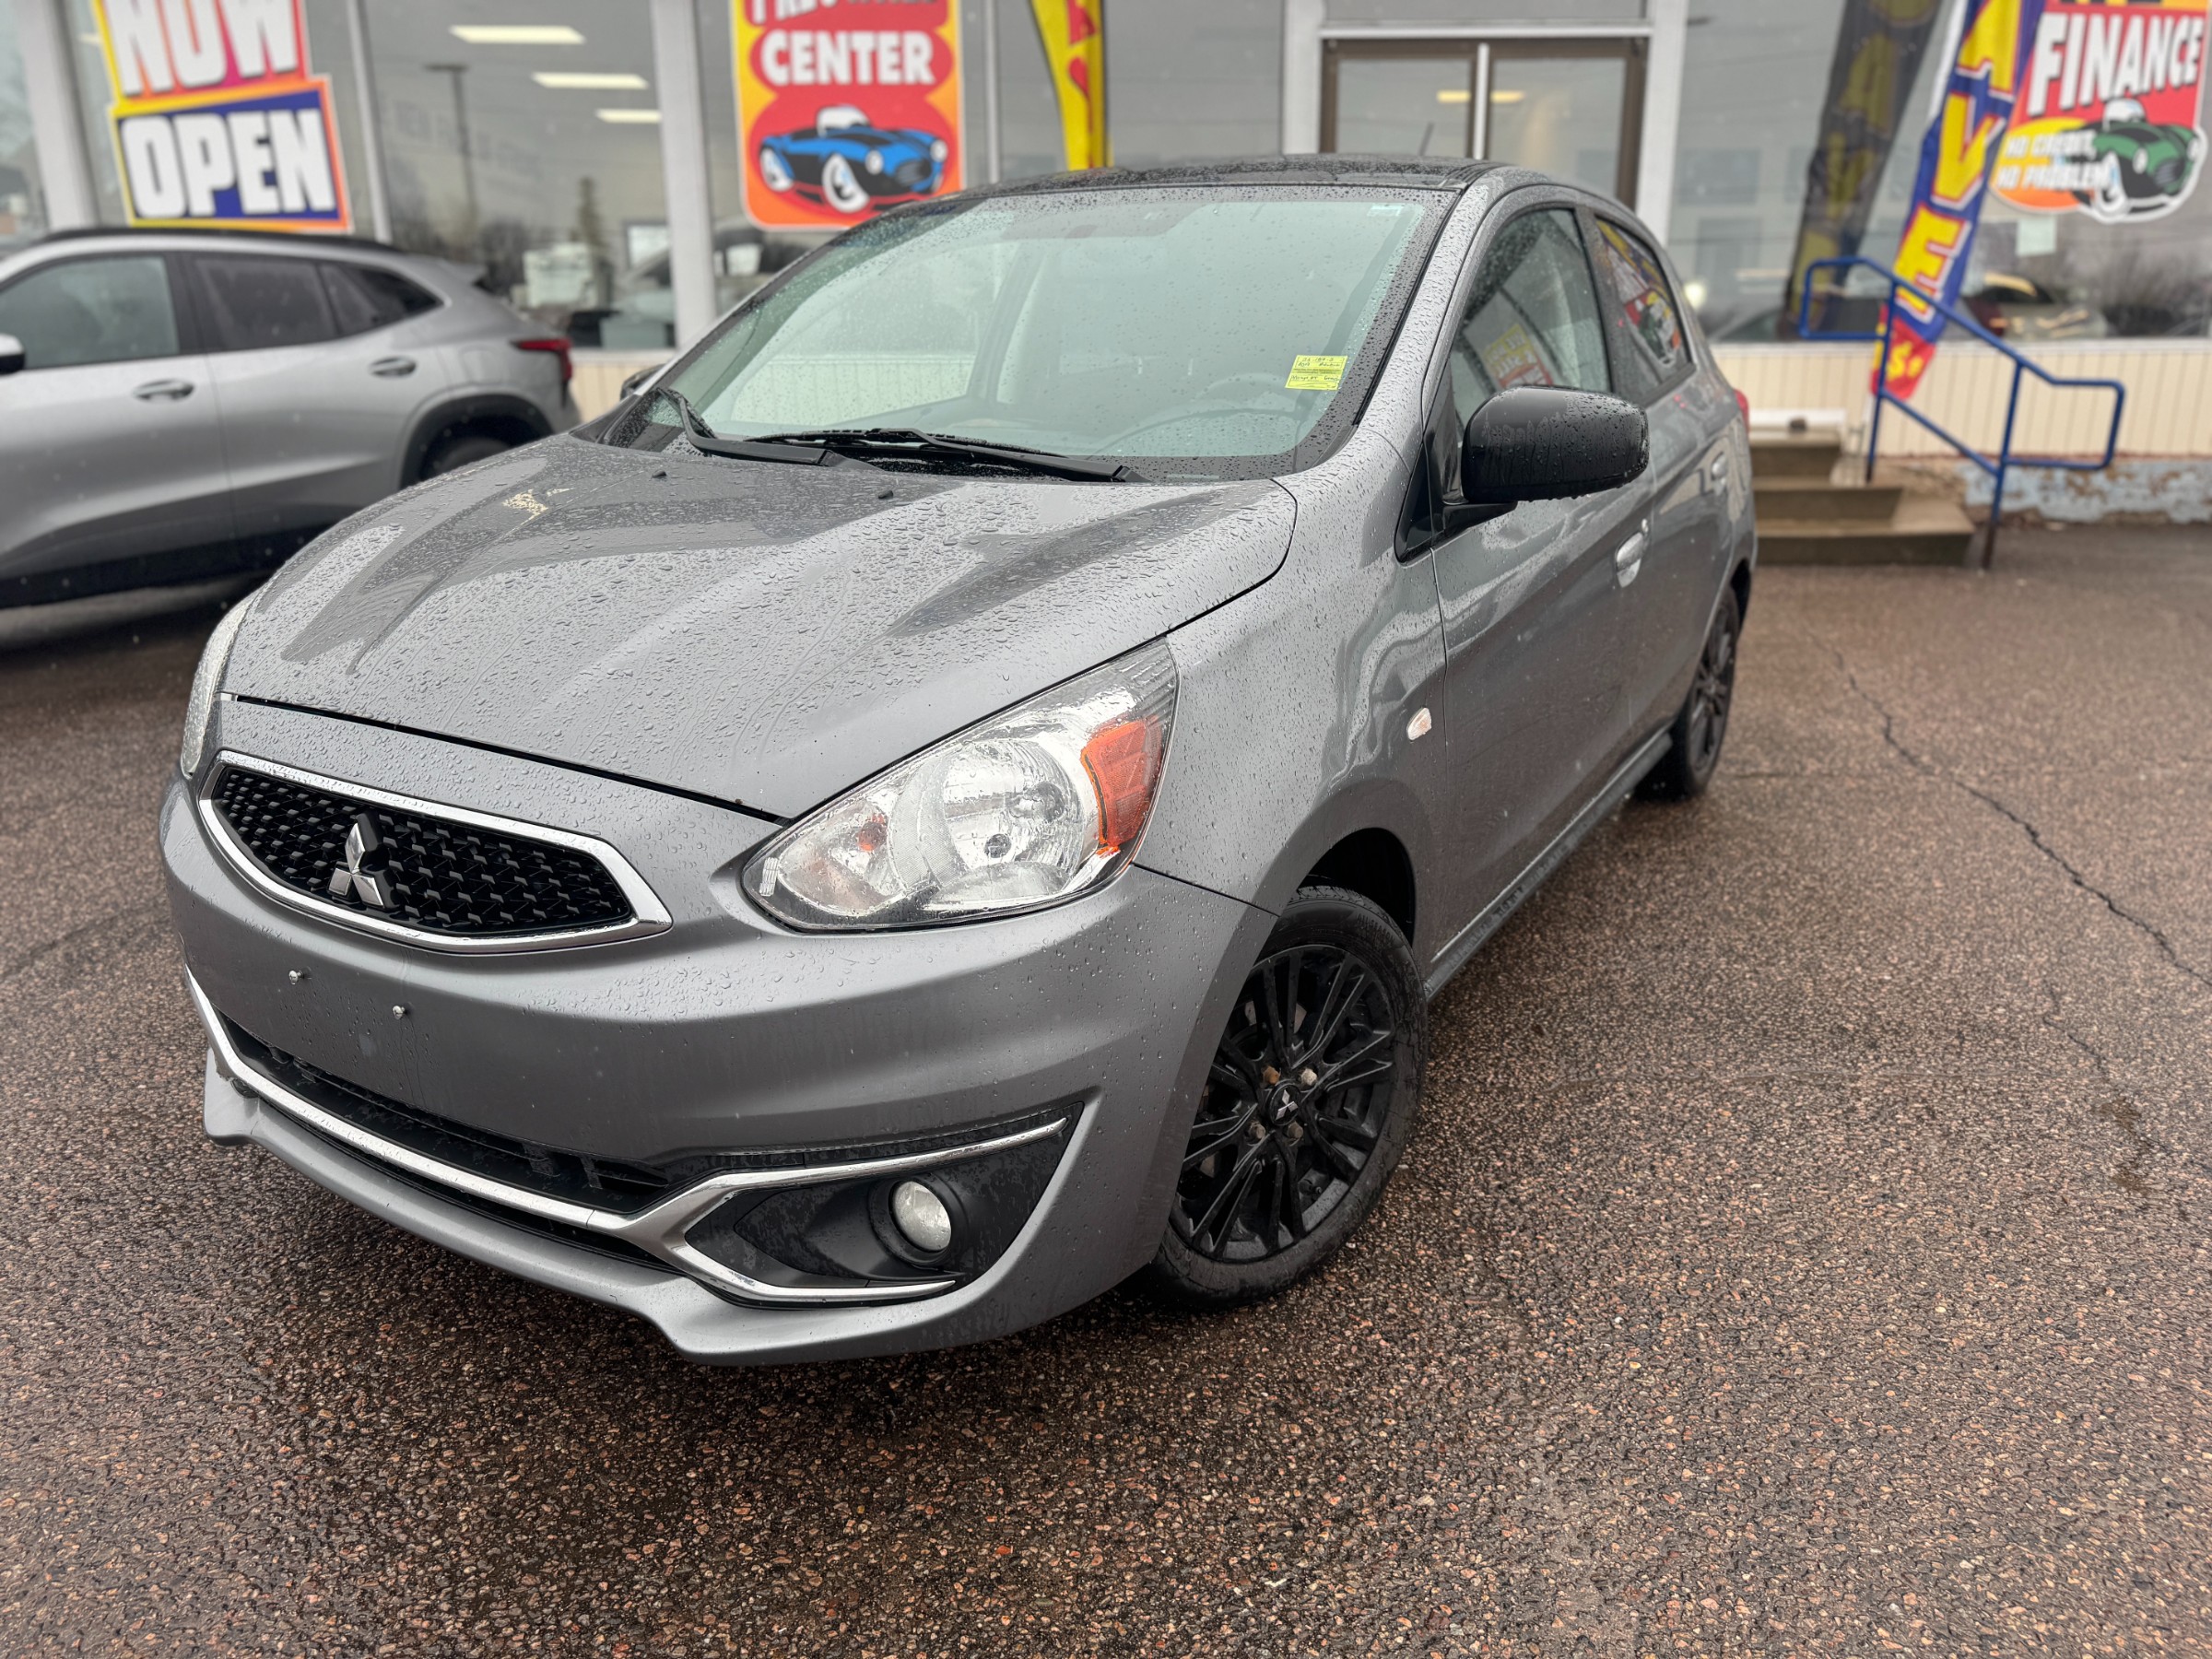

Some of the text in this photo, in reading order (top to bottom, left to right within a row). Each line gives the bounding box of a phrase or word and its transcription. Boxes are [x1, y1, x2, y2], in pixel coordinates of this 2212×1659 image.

[103, 0, 298, 96] NOW
[760, 29, 936, 86] CENTER
[2028, 11, 2205, 116] FINANCE
[121, 108, 336, 218] OPEN
[2006, 135, 2028, 158] NO
